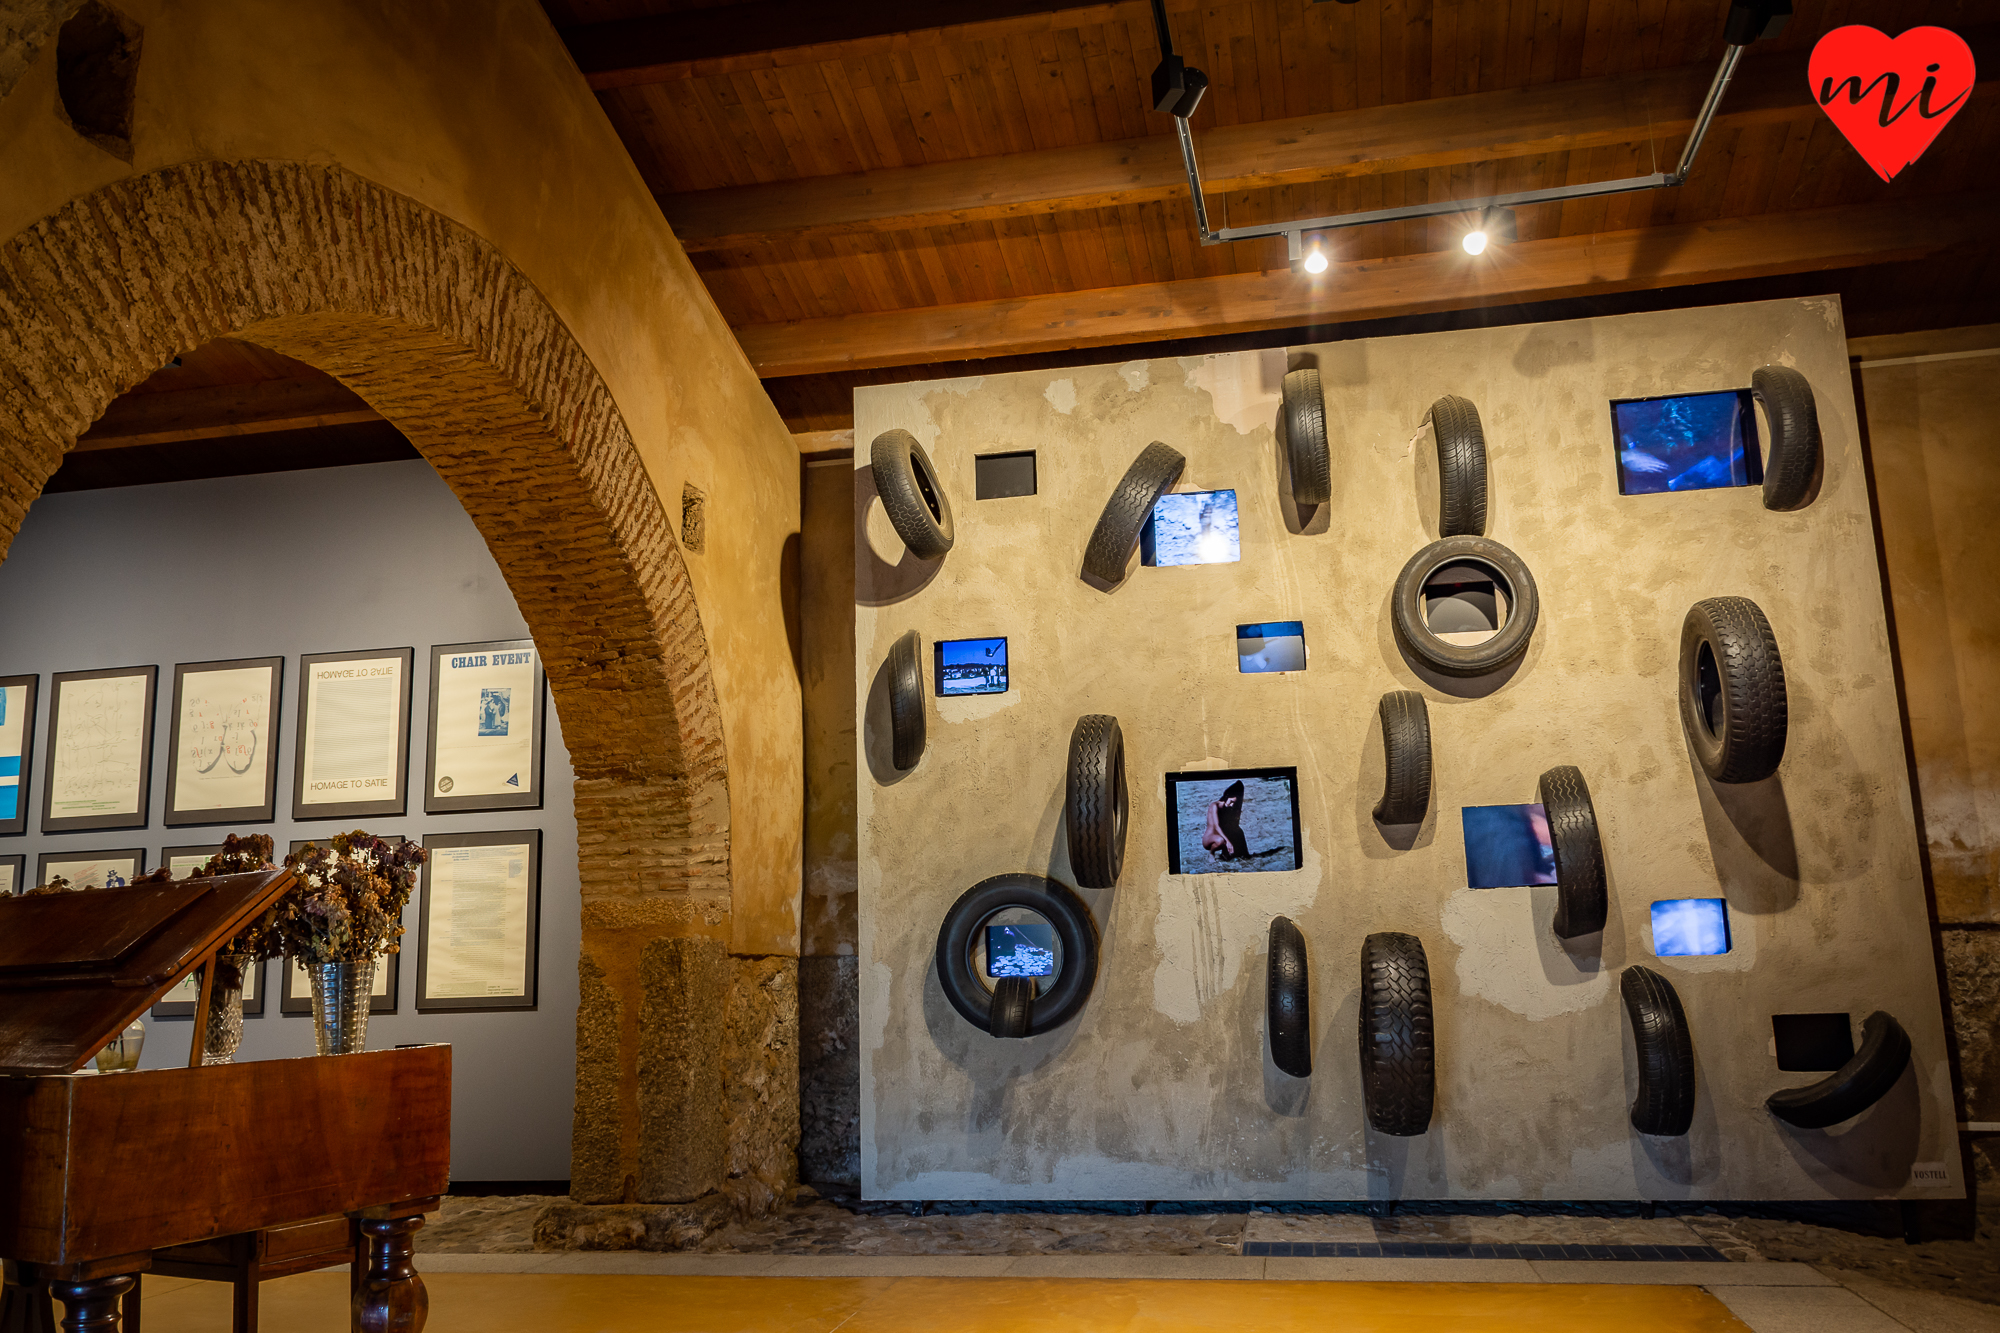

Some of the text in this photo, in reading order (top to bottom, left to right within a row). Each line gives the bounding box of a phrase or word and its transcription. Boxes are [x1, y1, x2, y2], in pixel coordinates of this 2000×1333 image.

[451, 652, 531, 669] CHAIR EVENT
[310, 779, 388, 790] HOMAGE TO SATIE
[1914, 1171, 1947, 1180] VOSTELL
